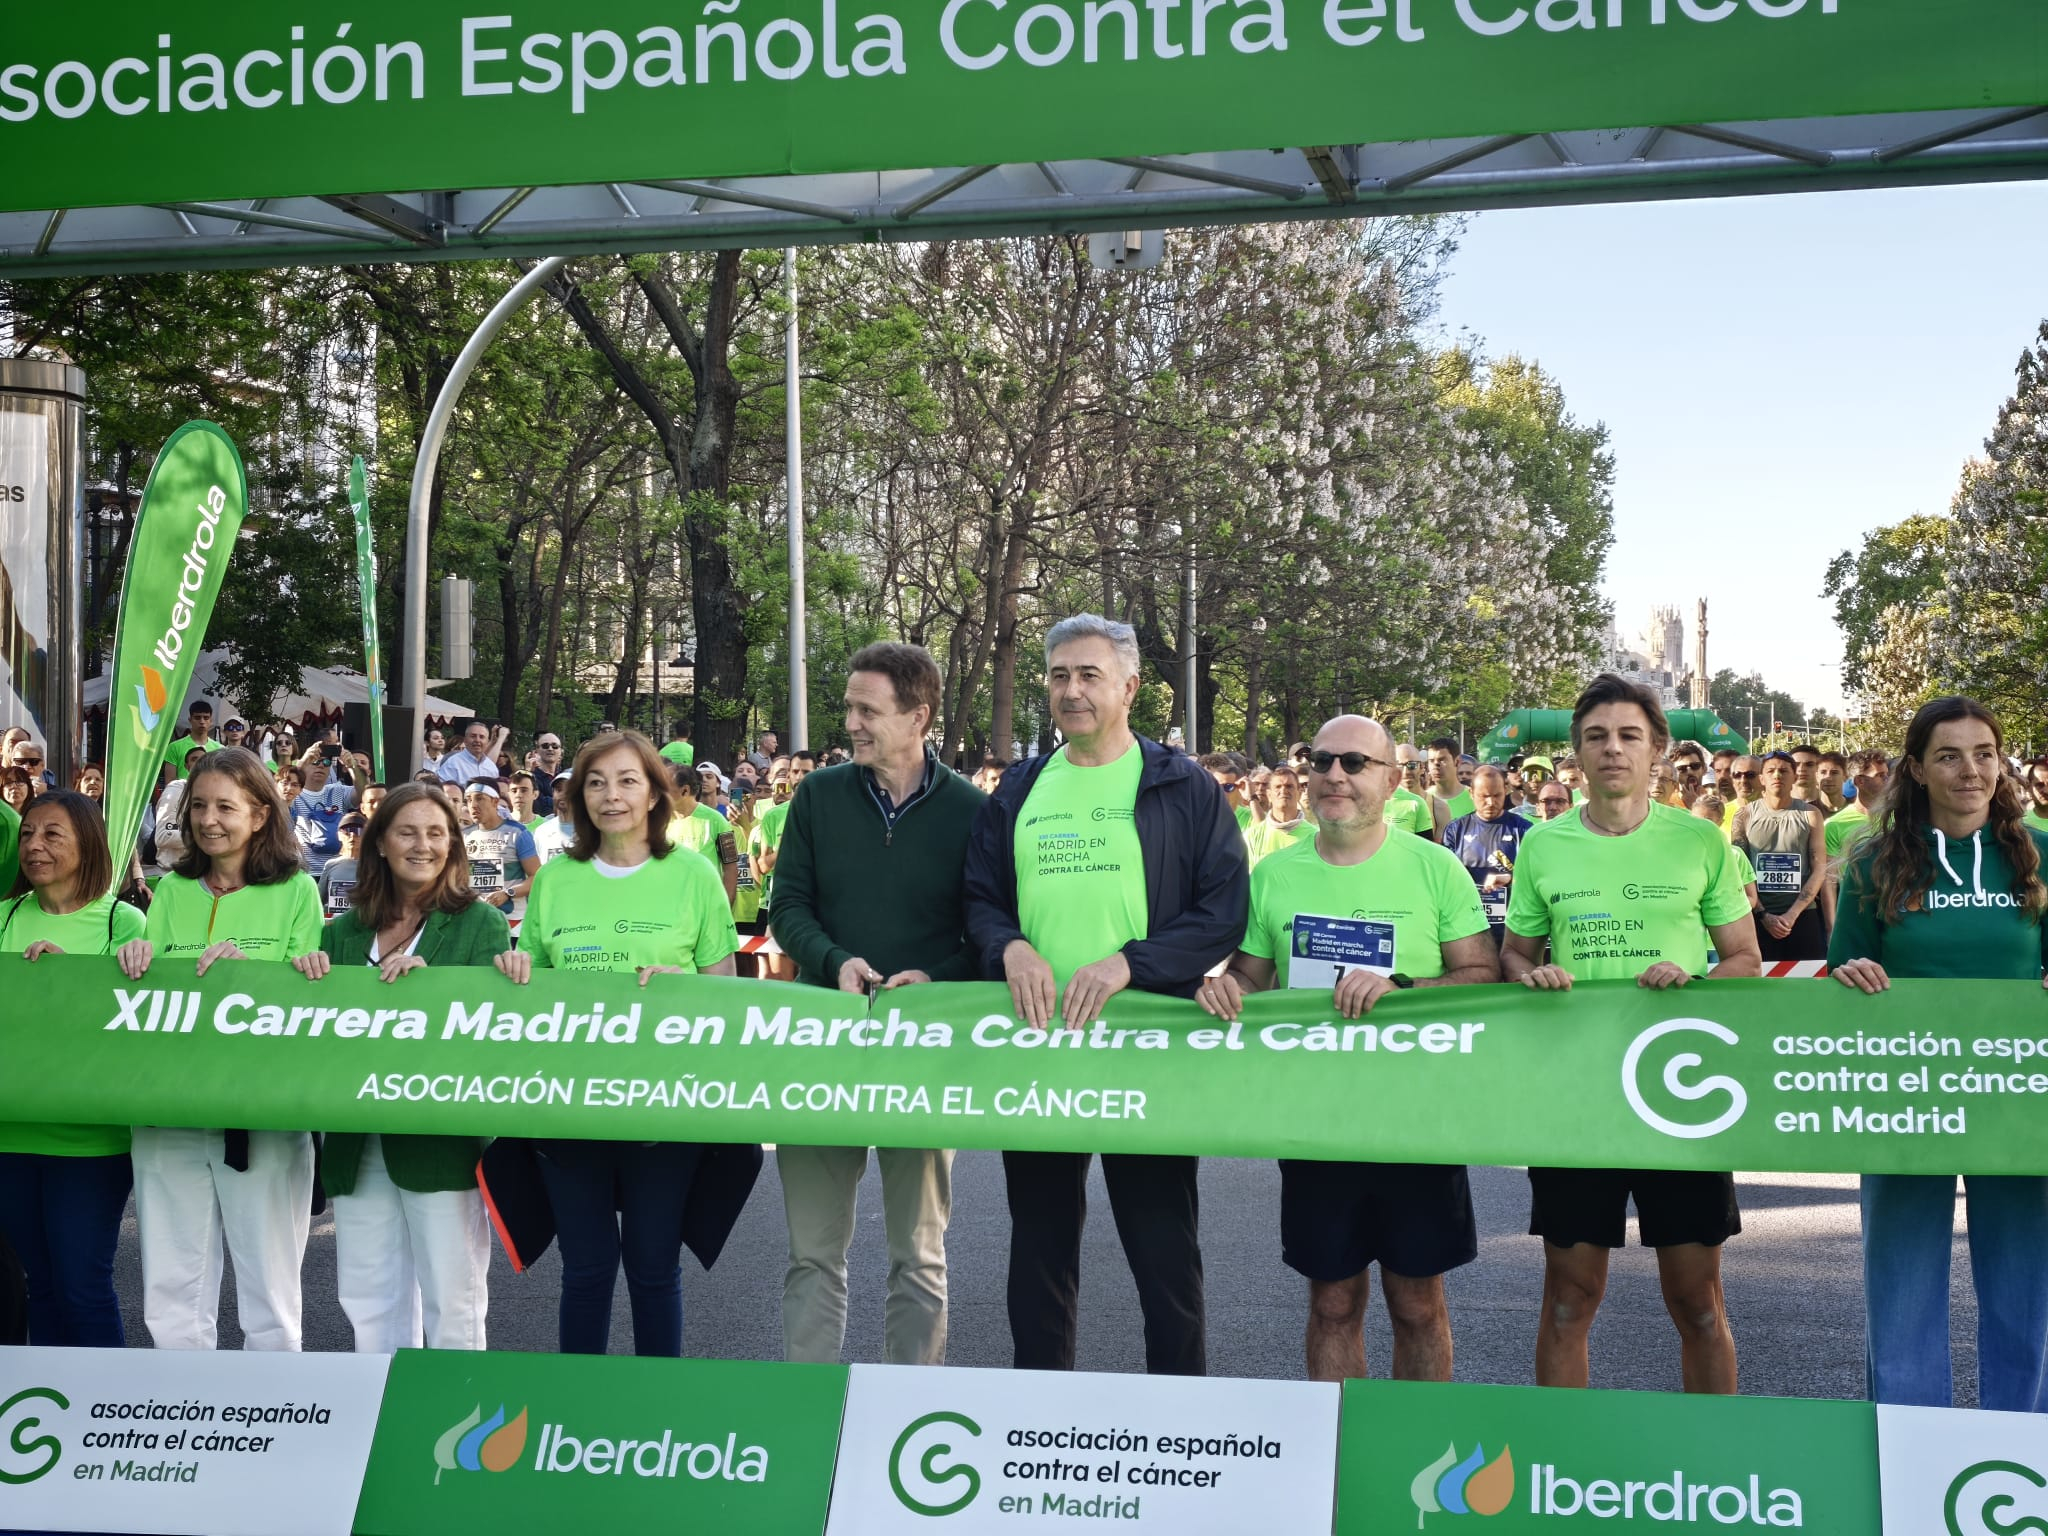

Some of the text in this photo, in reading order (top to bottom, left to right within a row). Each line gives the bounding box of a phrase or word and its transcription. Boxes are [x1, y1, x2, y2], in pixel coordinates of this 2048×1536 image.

[461, 0, 906, 114] Española
[940, 0, 1288, 70] Contra
[154, 485, 226, 671] Iberdrola
[1038, 837, 1106, 851] MADRID EN
[1038, 851, 1090, 865] MARCHA
[1038, 861, 1121, 876] CONTRA EL CÁNCER
[473, 875, 497, 886] 21677
[1763, 872, 1794, 883] 28821
[1561, 889, 1601, 901] Iberdrola
[1570, 919, 1644, 934] MADRID EN
[1312, 945, 1336, 954] contra
[1336, 946, 1345, 954] el
[1345, 947, 1373, 957] cáncer
[1571, 934, 1627, 948] MARCHA
[564, 951, 629, 965] MADRID EN
[1573, 947, 1662, 961] CONTRA EL CÁNCER
[1333, 965, 1346, 987] 7
[104, 989, 1486, 1054] XIII Carrera Madrid en Marcha Contra el Cáncer
[1773, 1030, 1962, 1057] asociación
[1773, 1065, 2048, 1094] contra el cánce
[356, 1070, 1147, 1119] ASOCIACIÓN ESPAÑOLA CONTRA EL CÁNCER
[1774, 1105, 1966, 1134] en Madrid
[90, 1398, 331, 1428] asociación española
[82, 1428, 274, 1453] contra el cáncer
[534, 1423, 769, 1482] Iberdrola
[1006, 1426, 1282, 1460] asociación española
[73, 1459, 199, 1483] en Madrid
[1003, 1458, 1222, 1488] contra el cáncer
[998, 1492, 1141, 1520] en Madrid
[1531, 1463, 1803, 1527] Iberdrola
